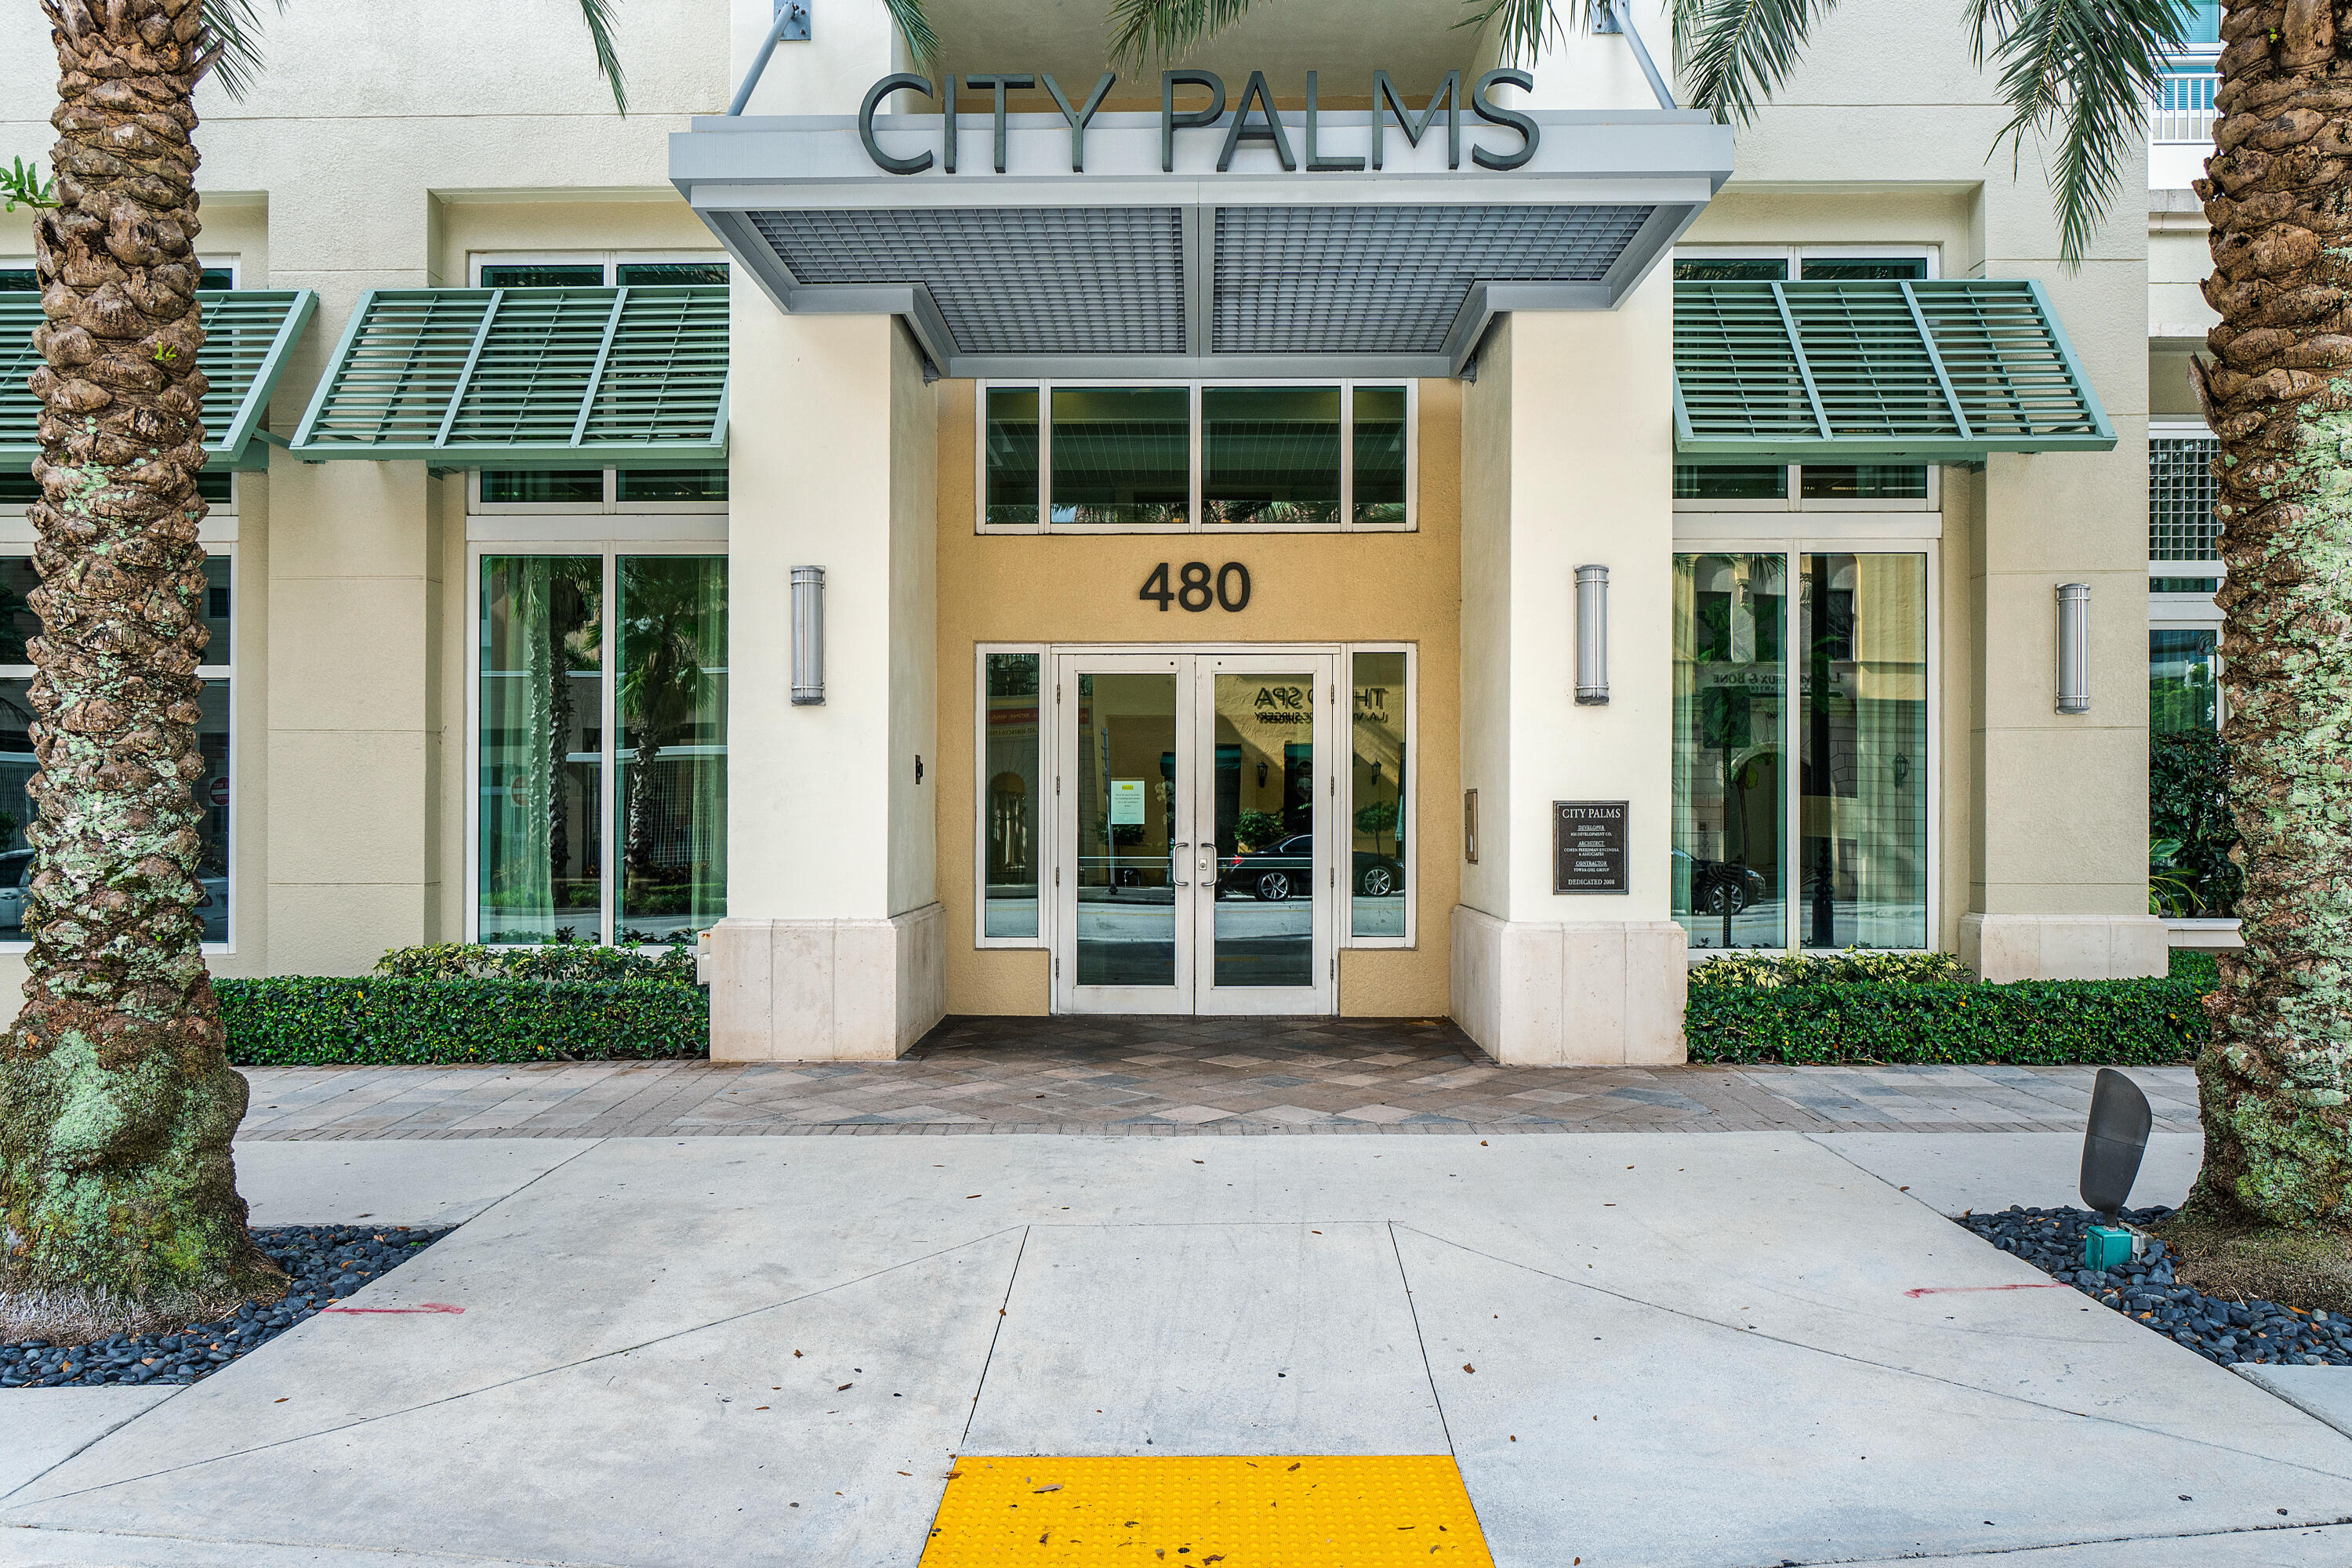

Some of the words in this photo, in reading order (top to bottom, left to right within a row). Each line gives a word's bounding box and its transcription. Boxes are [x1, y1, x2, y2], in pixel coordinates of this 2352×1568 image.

[858, 71, 1116, 176] CITY
[1161, 69, 1541, 172] PALMS
[1140, 561, 1251, 613] 480
[1562, 808, 1586, 818] CITY
[1588, 808, 1621, 818] PALMS
